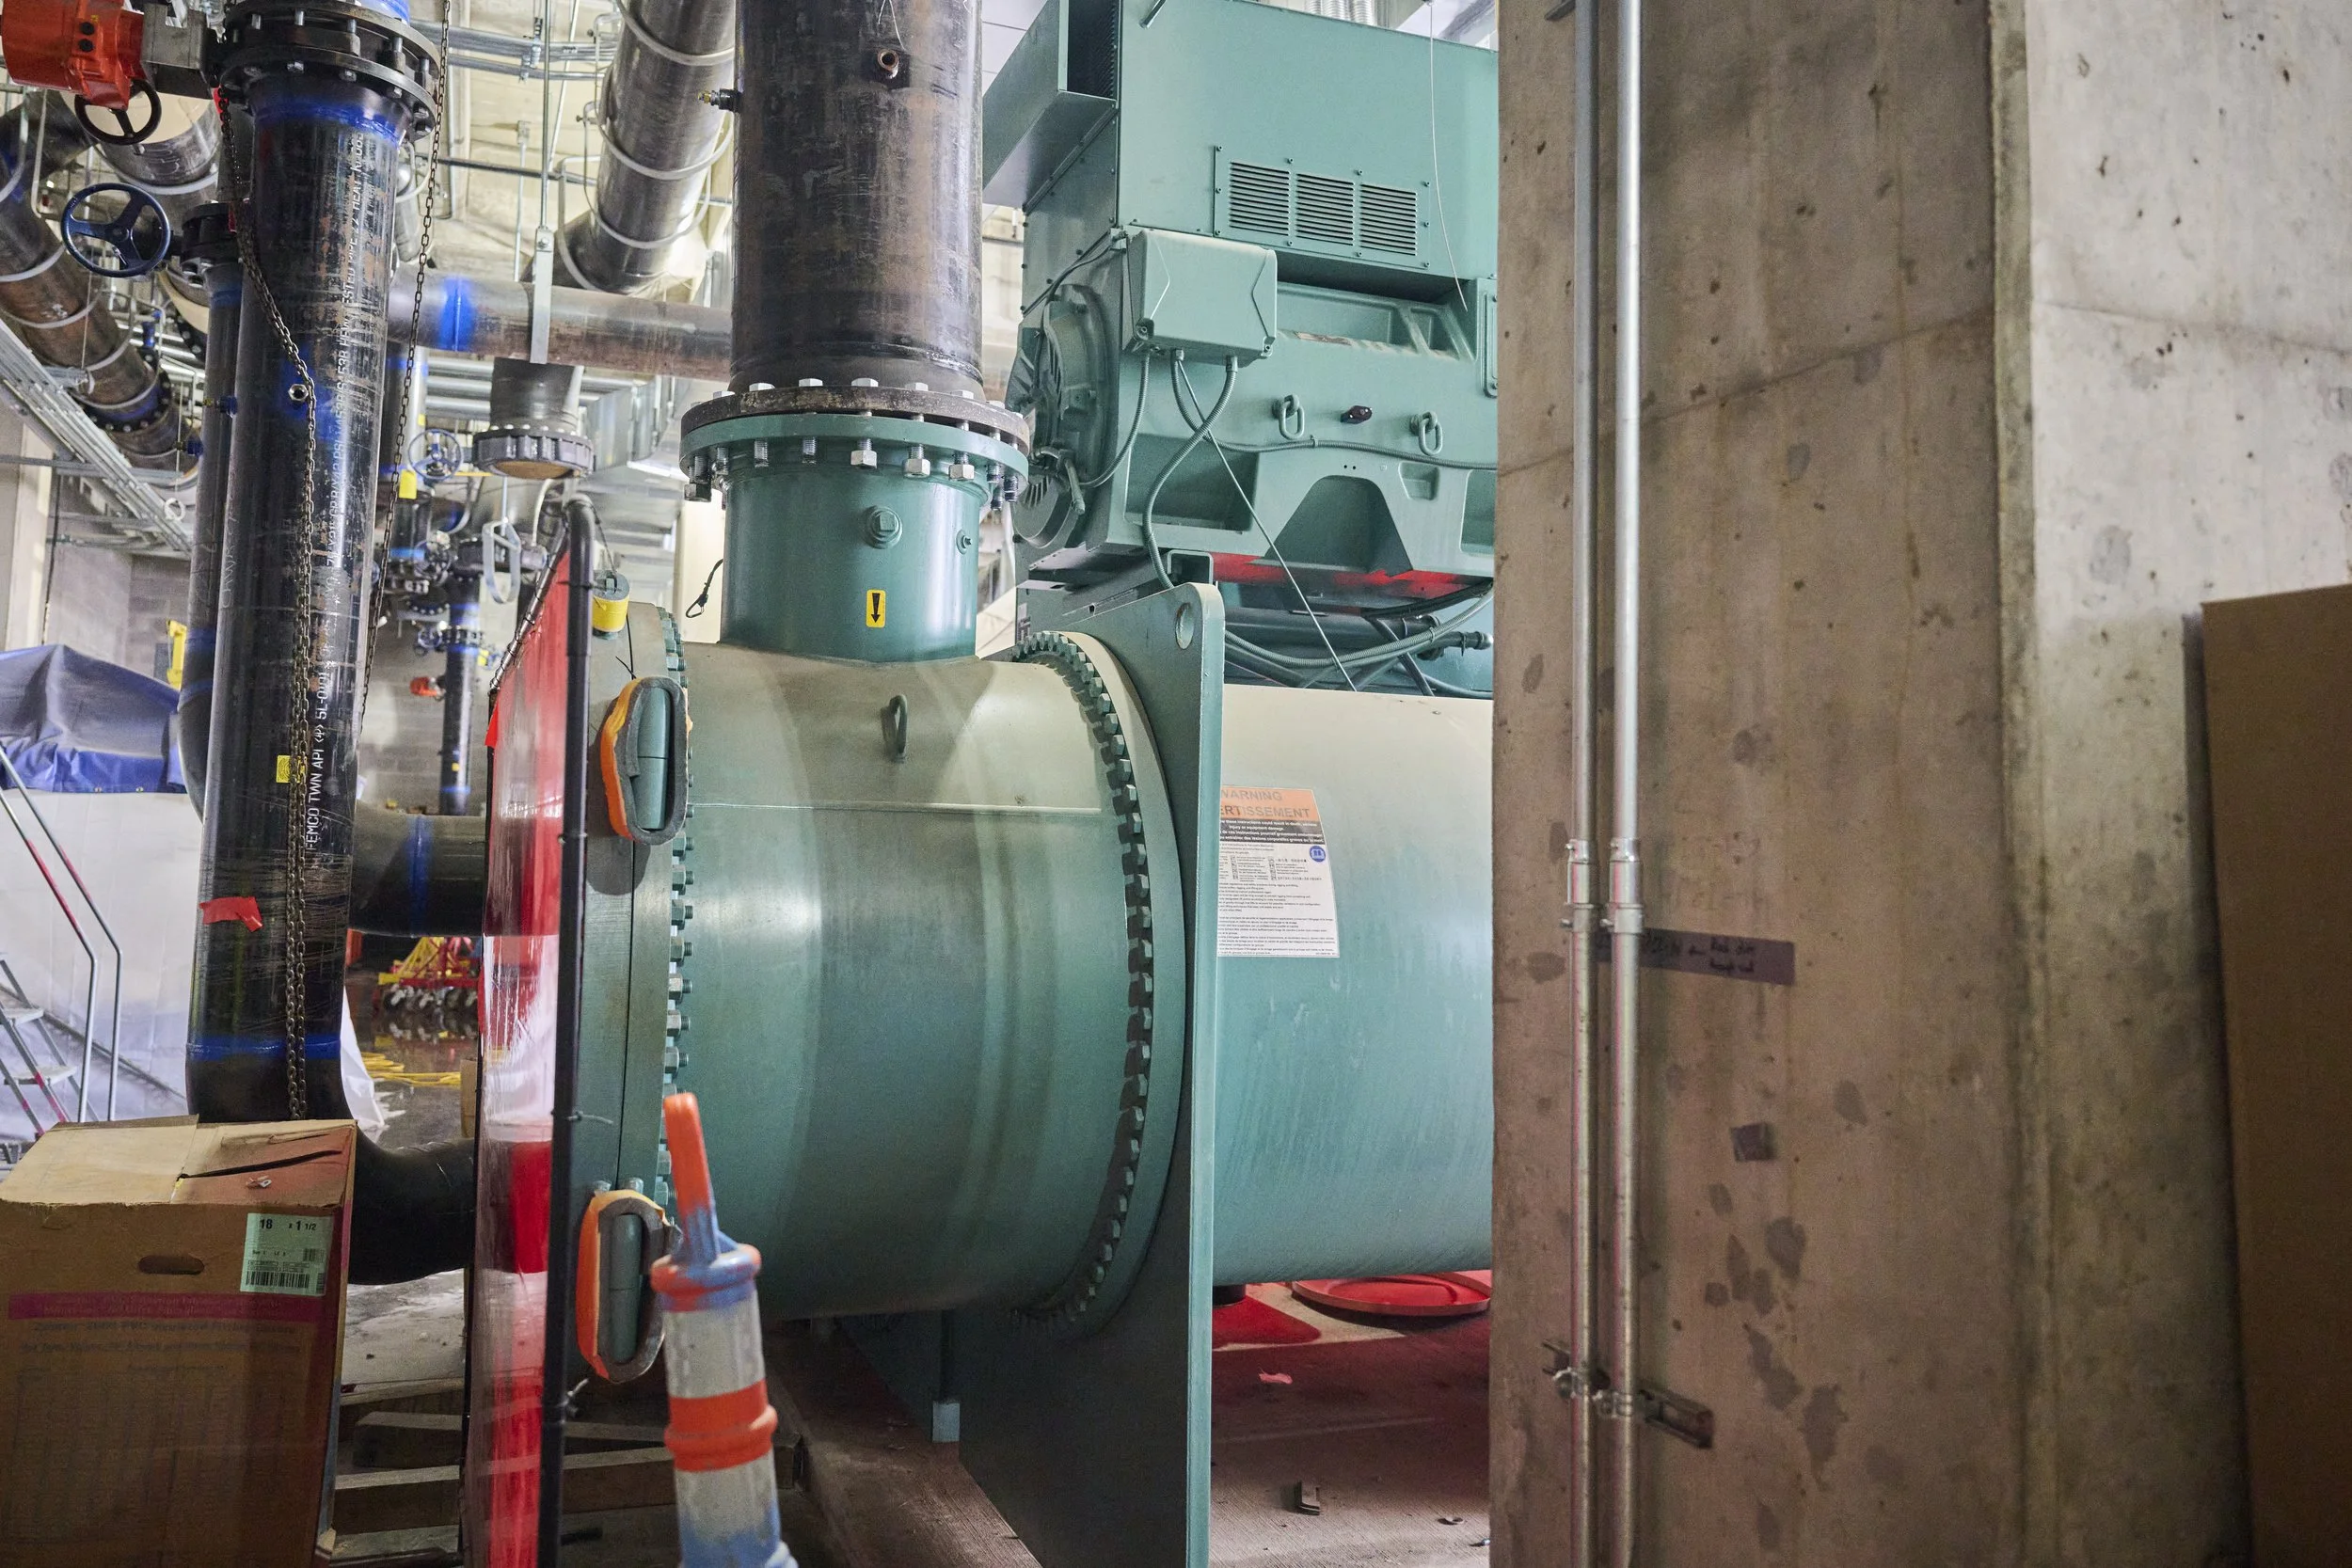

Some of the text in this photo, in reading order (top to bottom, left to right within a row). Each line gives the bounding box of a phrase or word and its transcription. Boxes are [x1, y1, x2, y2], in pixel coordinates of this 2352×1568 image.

[341, 268, 356, 312] ESTED
[311, 749, 325, 769] API
[308, 773, 323, 803] TWN
[1221, 789, 1282, 800] WARNING
[1220, 805, 1311, 817] ERTISSEMENT
[306, 807, 320, 850] FEMCO
[260, 1218, 273, 1229] 18
[295, 1220, 301, 1230] 1
